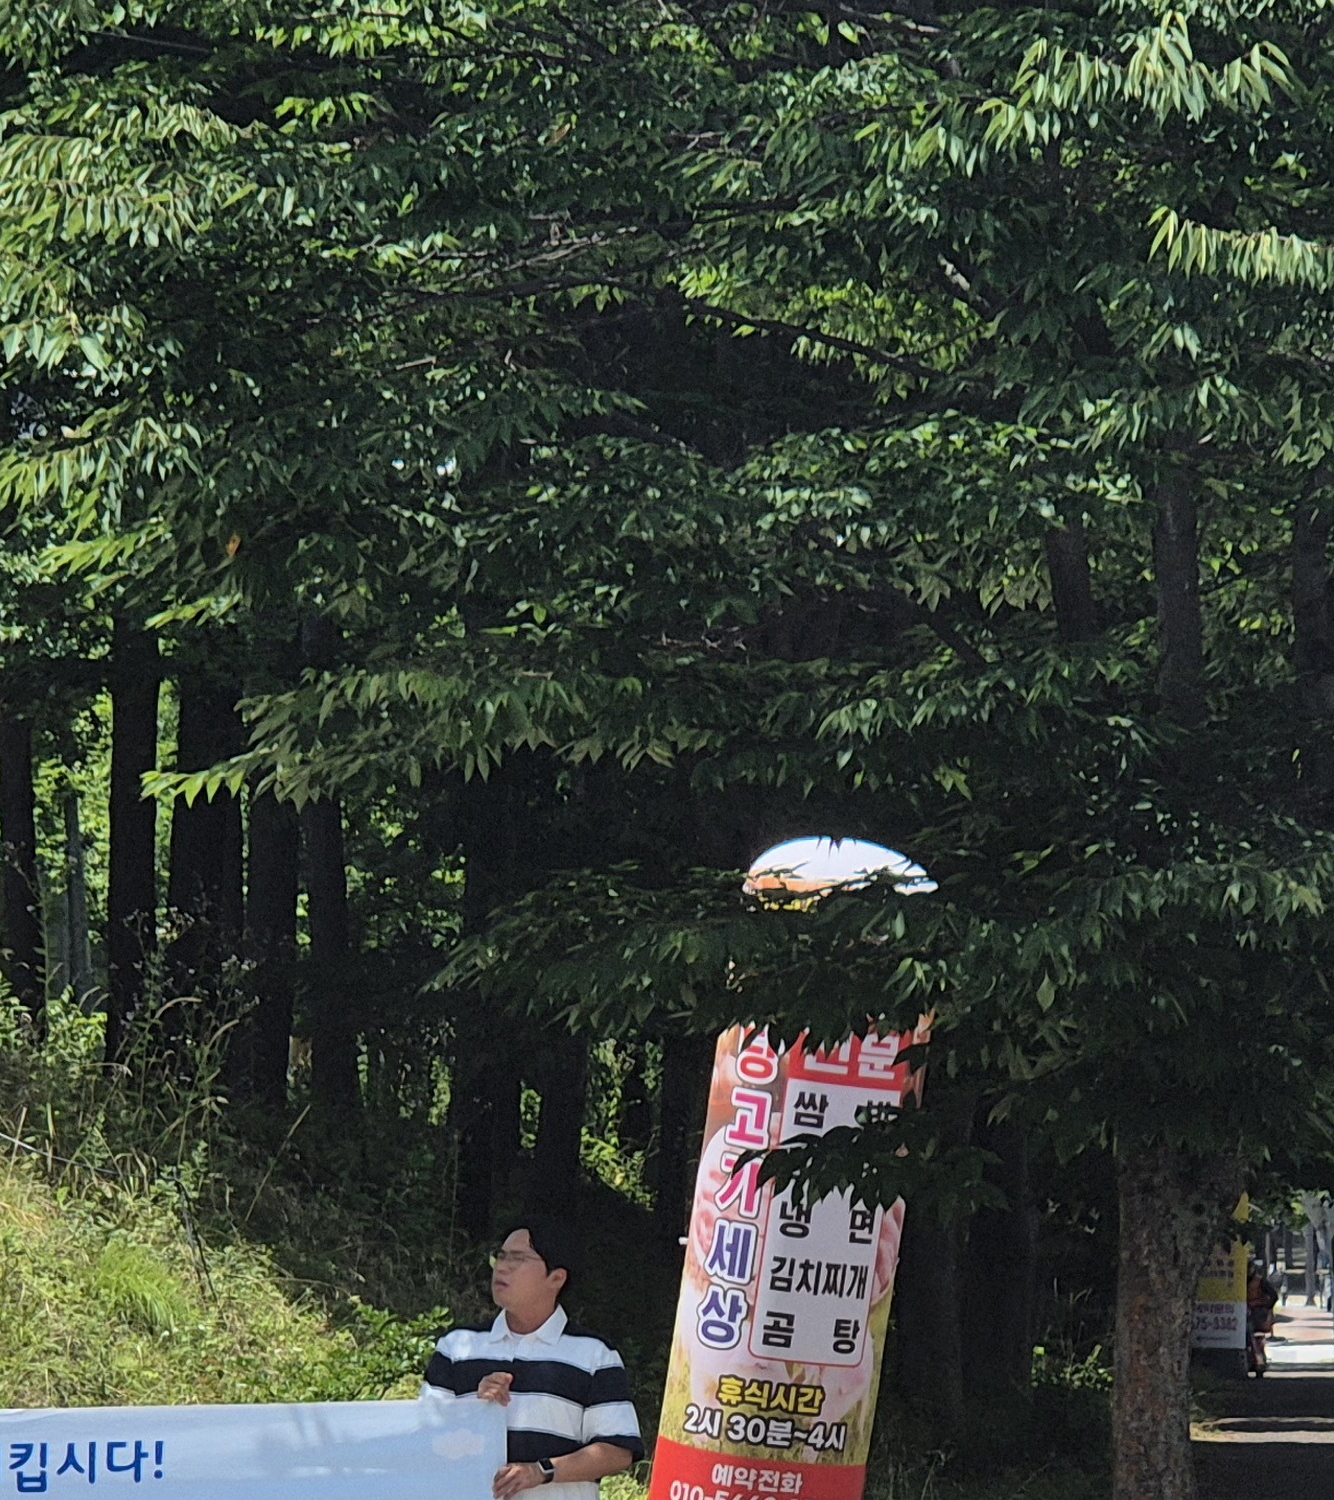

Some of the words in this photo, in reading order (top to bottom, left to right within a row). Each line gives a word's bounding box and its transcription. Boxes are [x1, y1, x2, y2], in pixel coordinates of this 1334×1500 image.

[770, 1255, 869, 1300] 김치찌개
[717, 1375, 825, 1416] 휴식시간
[684, 1405, 722, 1438] 2시
[728, 1415, 848, 1451] 30분~4시
[711, 1463, 803, 1495] 예약전화
